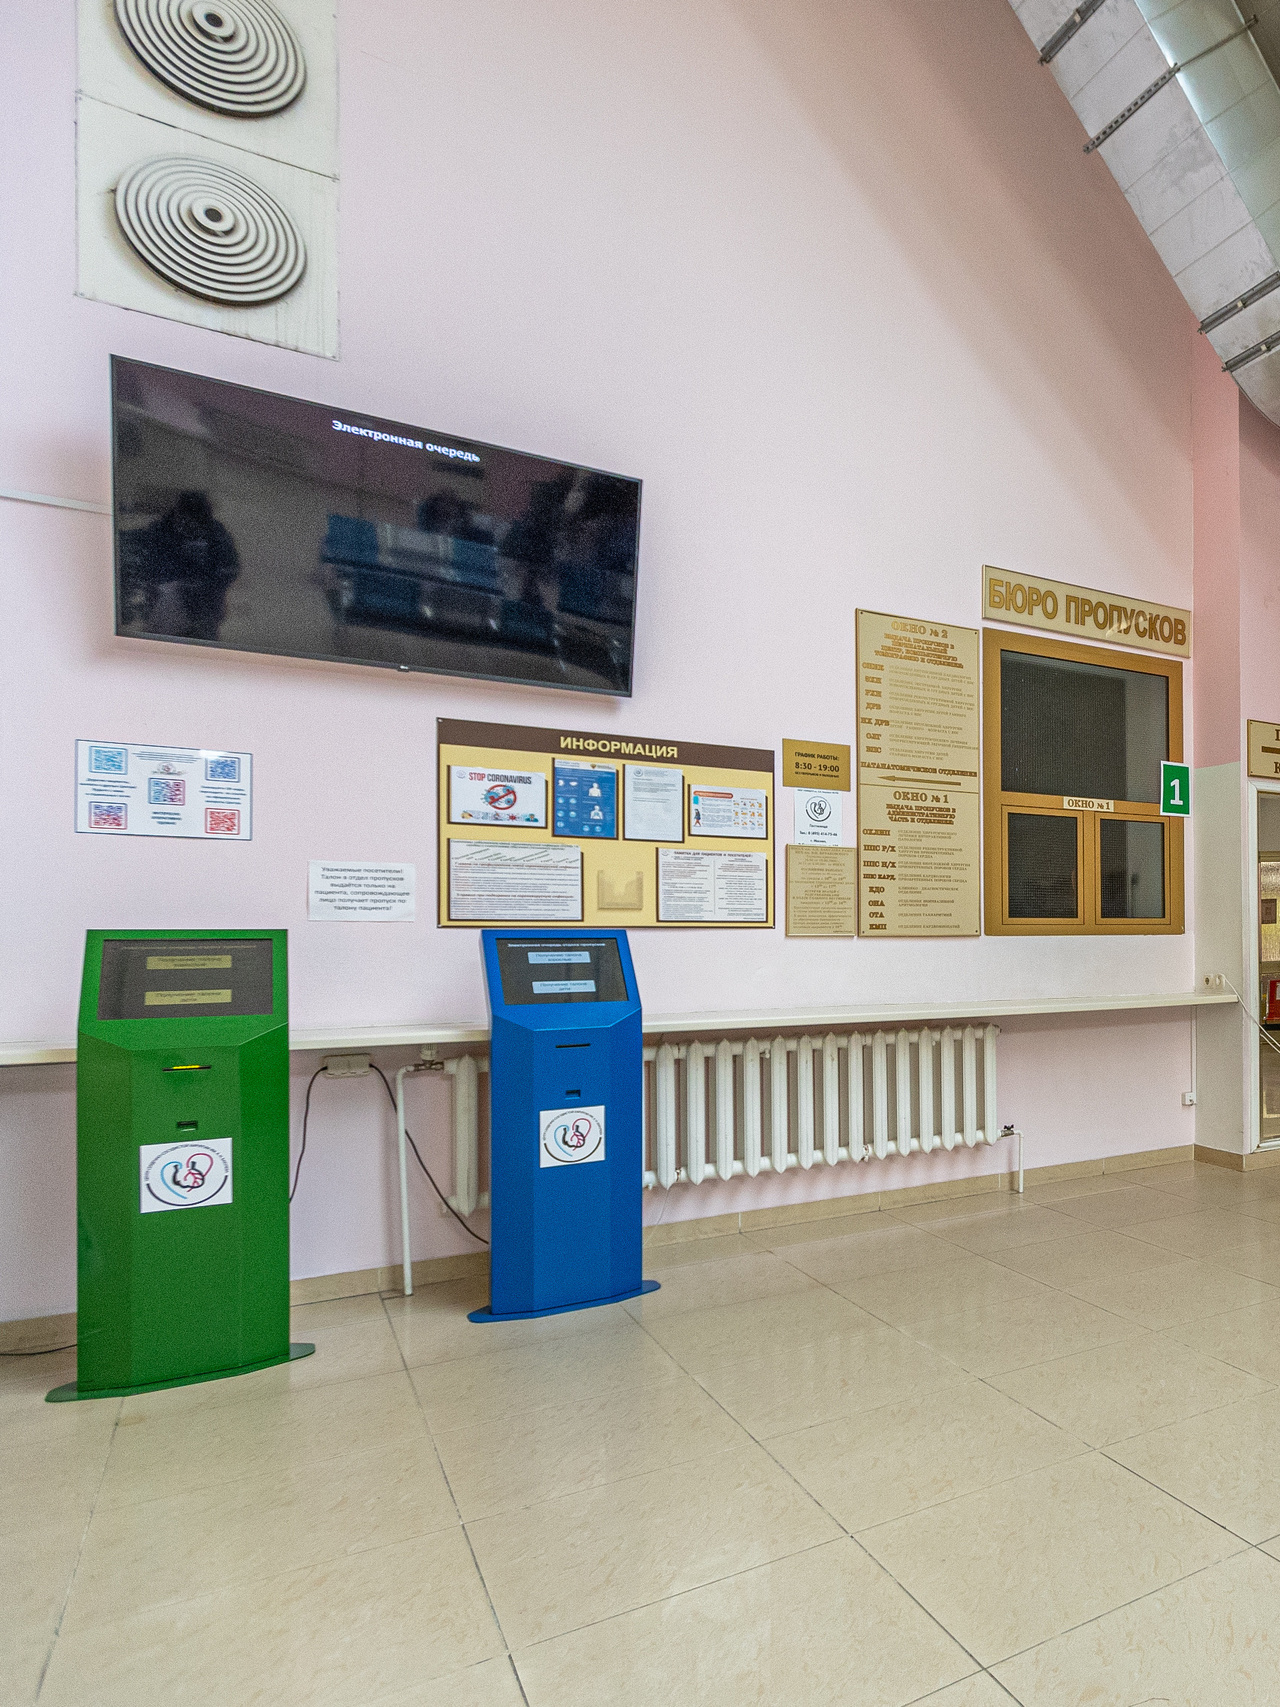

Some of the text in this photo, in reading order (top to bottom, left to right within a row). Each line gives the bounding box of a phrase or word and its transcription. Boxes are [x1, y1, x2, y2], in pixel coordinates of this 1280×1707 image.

[332, 420, 481, 463] Электронная очередь
[988, 578, 1187, 646] БЮРО ПРОПУСКОВ
[891, 621, 948, 639] ОКНО № 2
[559, 736, 678, 759] ИНФОРМАЦИЯ
[795, 751, 840, 761] ГРАФИК РАБОТЫ:
[795, 762, 812, 770] 8:30
[818, 764, 840, 773] 19:00
[468, 772, 532, 785] STOP CORONAVIRUS
[893, 790, 949, 804] ОКНО № 1
[1170, 778, 1184, 805] 1
[1067, 799, 1110, 810] ОКНО № 1
